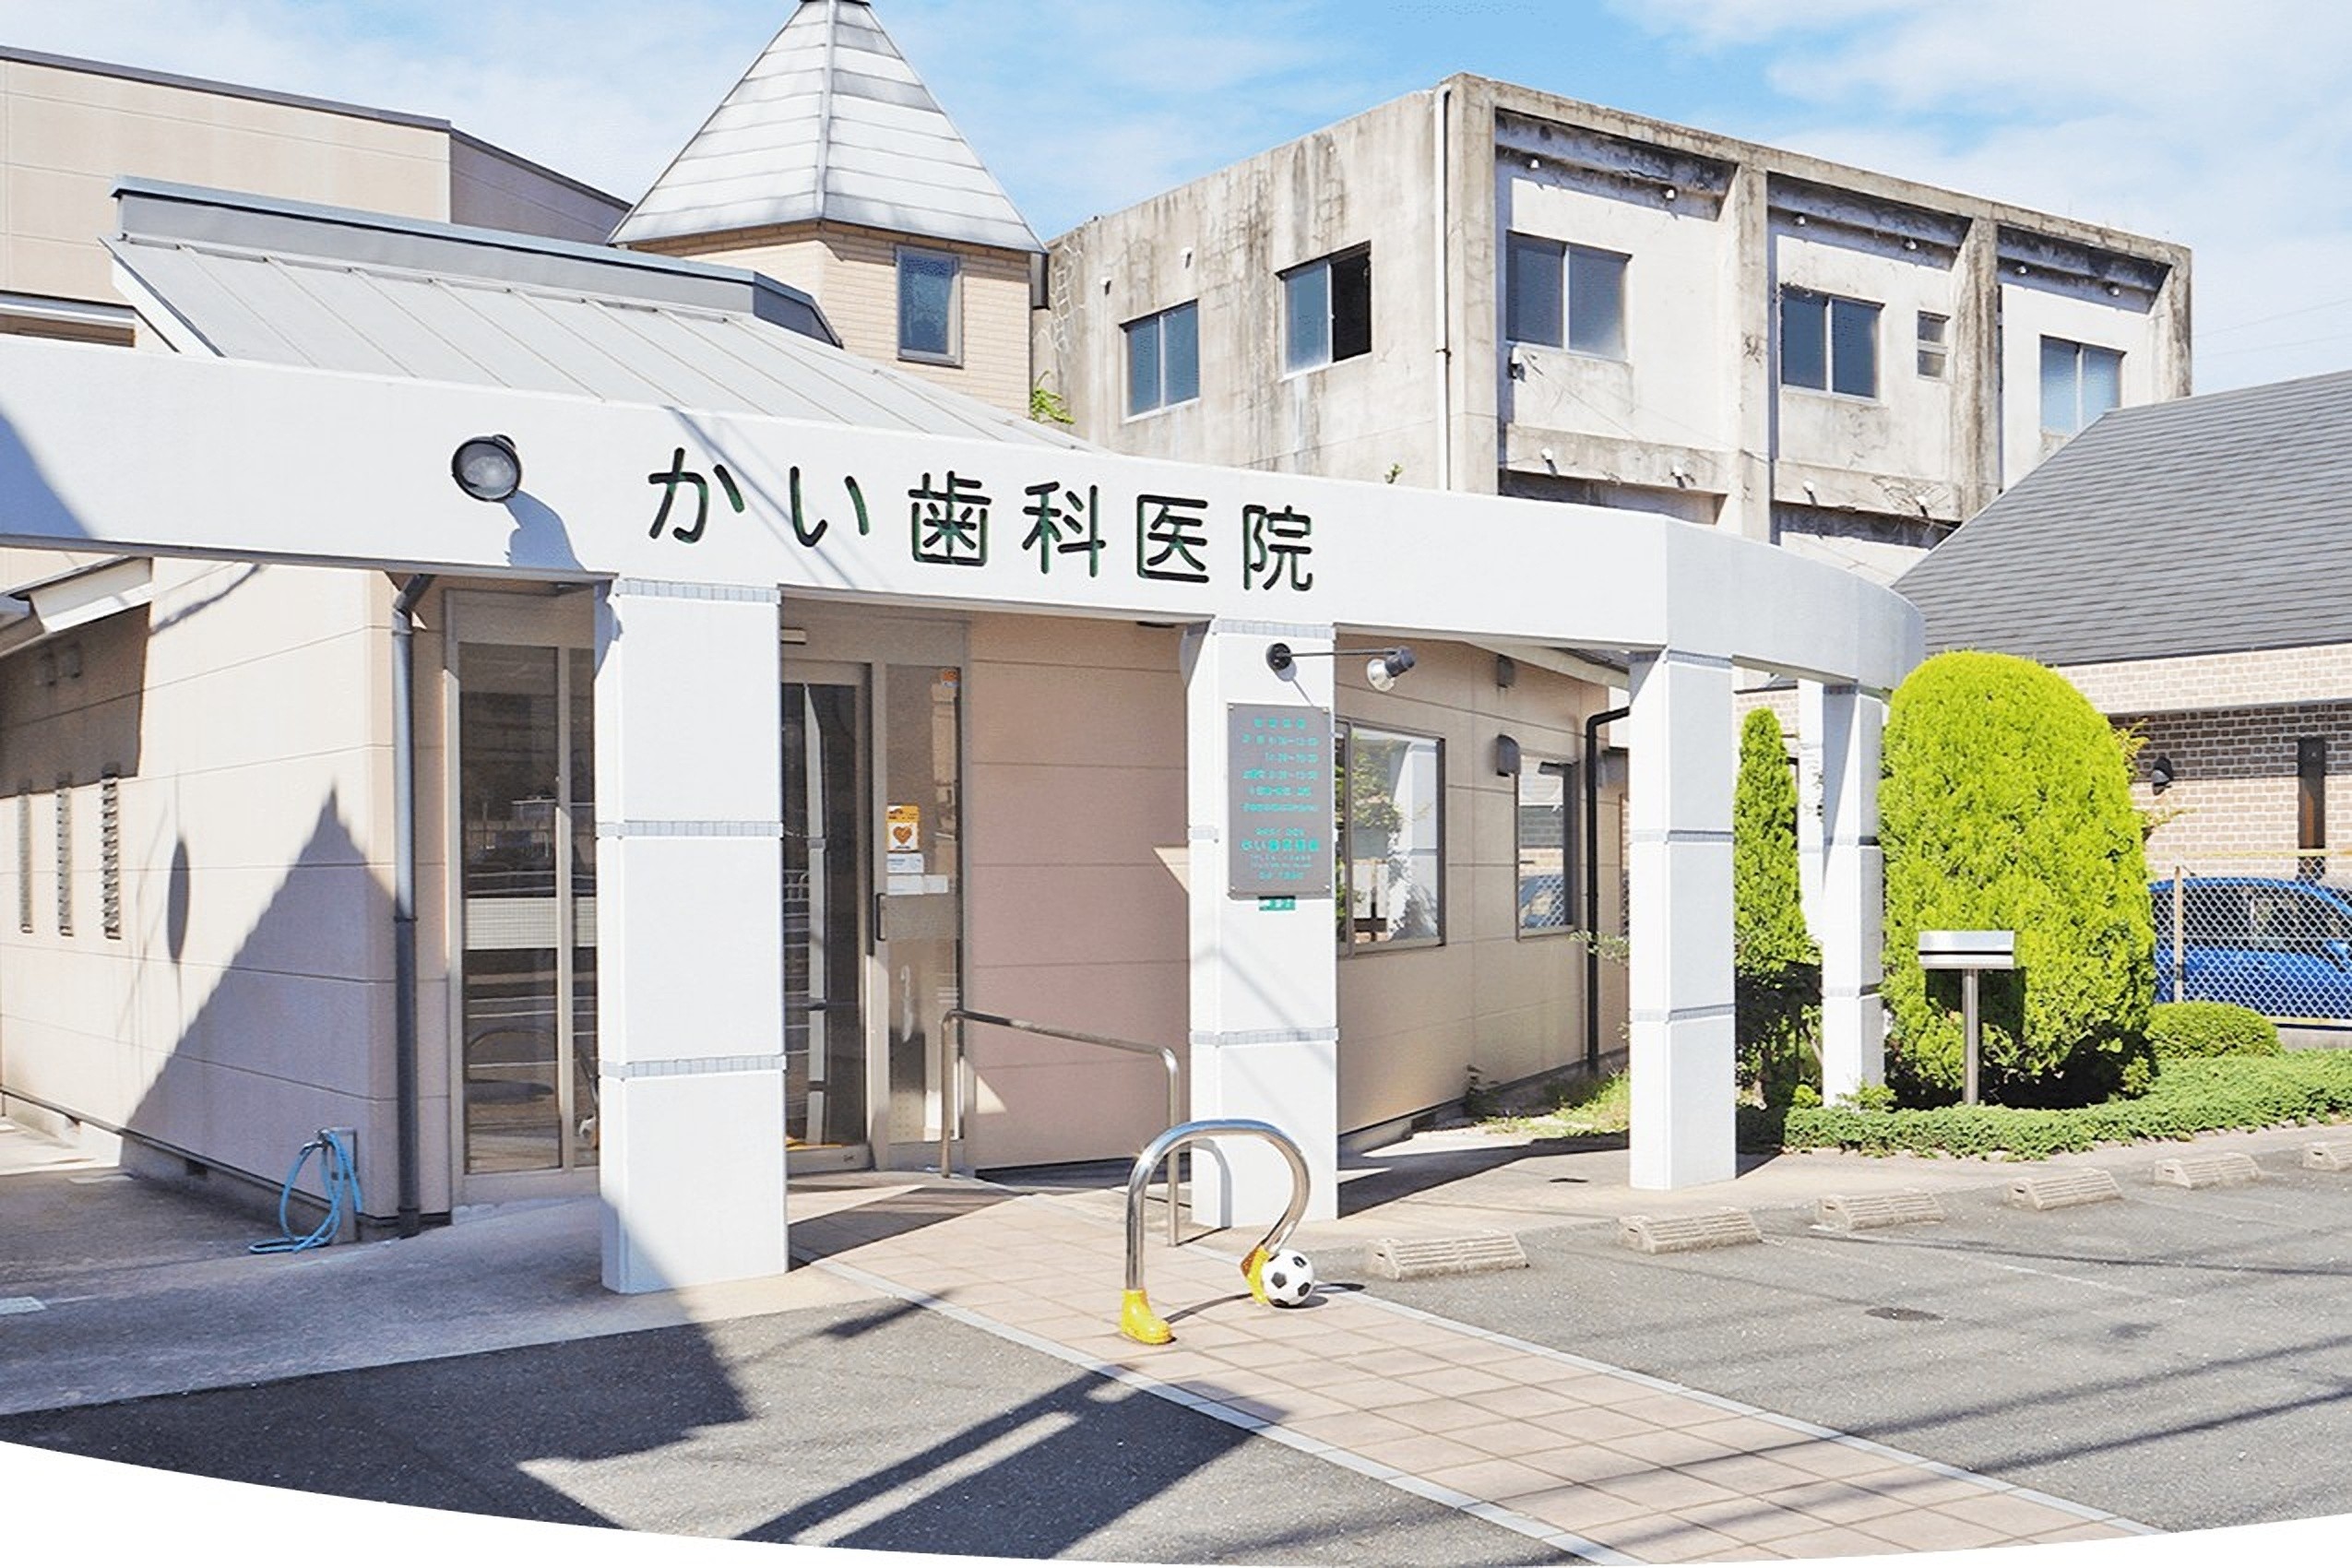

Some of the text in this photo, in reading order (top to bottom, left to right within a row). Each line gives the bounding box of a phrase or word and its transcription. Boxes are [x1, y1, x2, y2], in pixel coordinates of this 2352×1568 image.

[647, 446, 1314, 592] かい歯科医院
